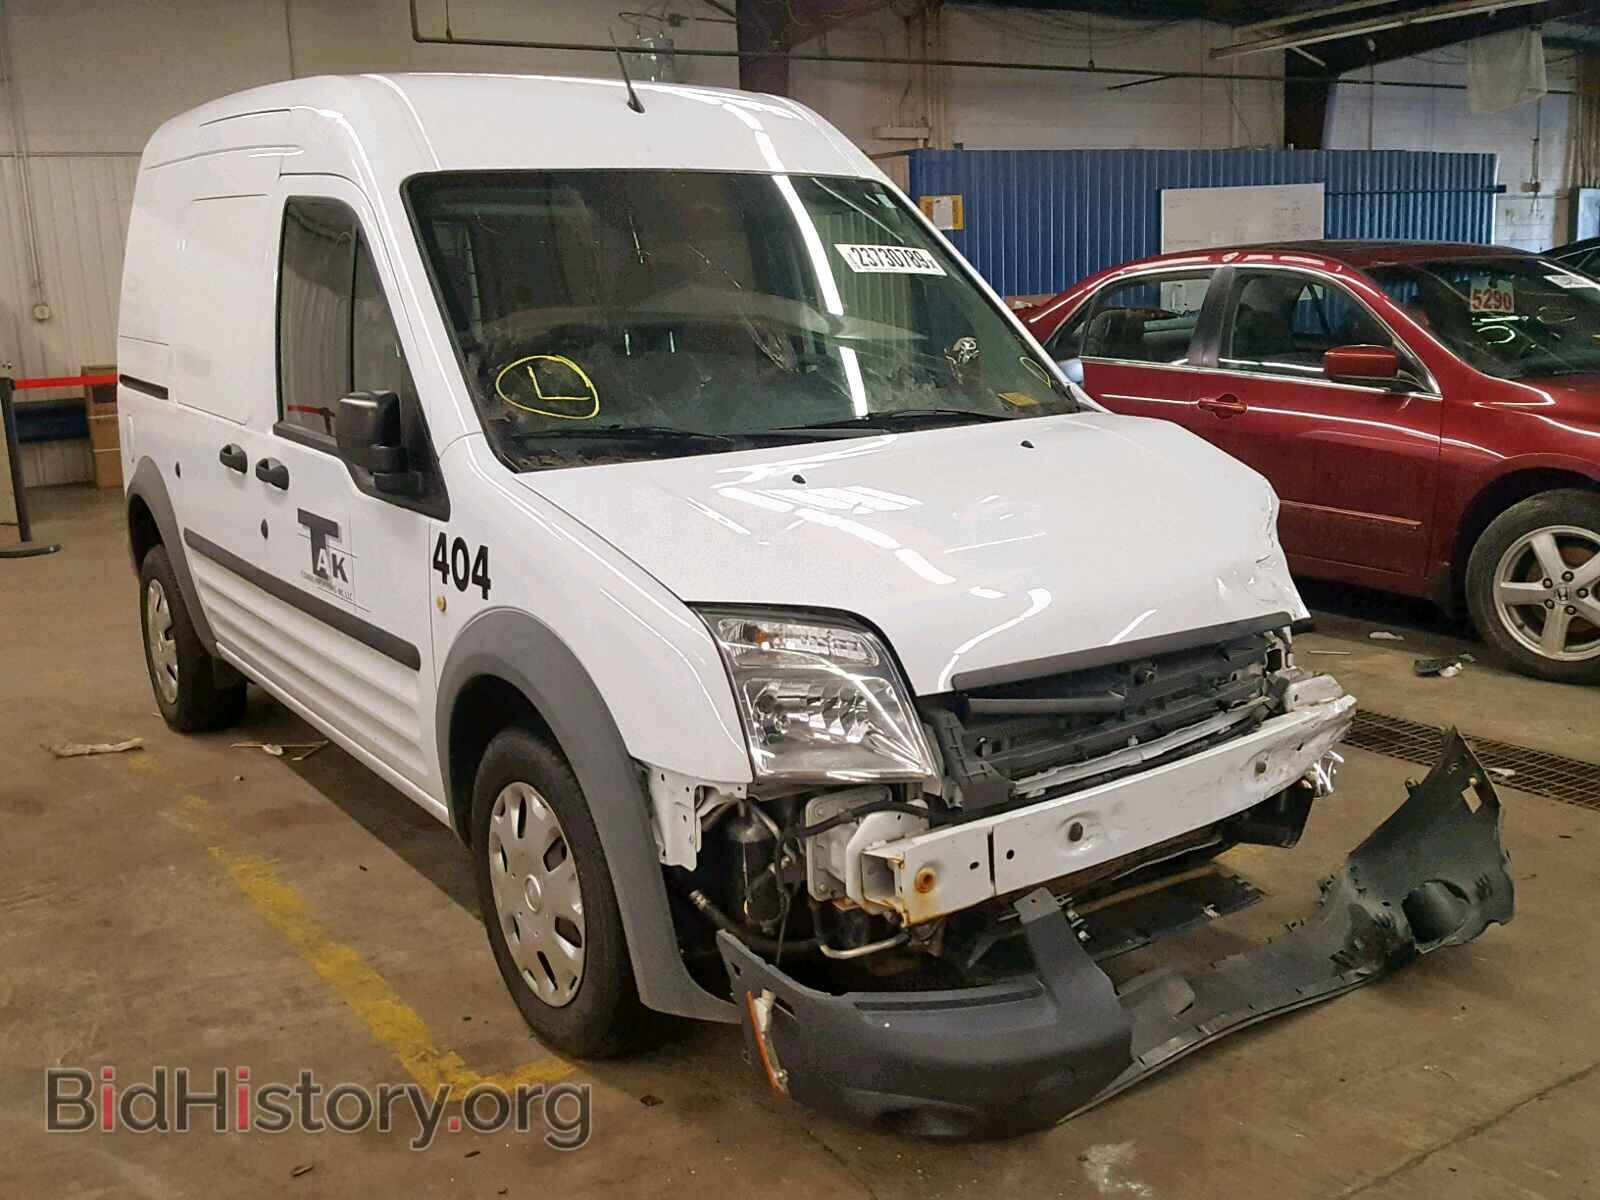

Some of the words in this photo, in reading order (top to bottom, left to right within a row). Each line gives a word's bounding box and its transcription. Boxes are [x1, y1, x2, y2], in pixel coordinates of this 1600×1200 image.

[850, 246, 930, 269] 23730789
[297, 507, 349, 584] TAK
[432, 531, 491, 601] 404
